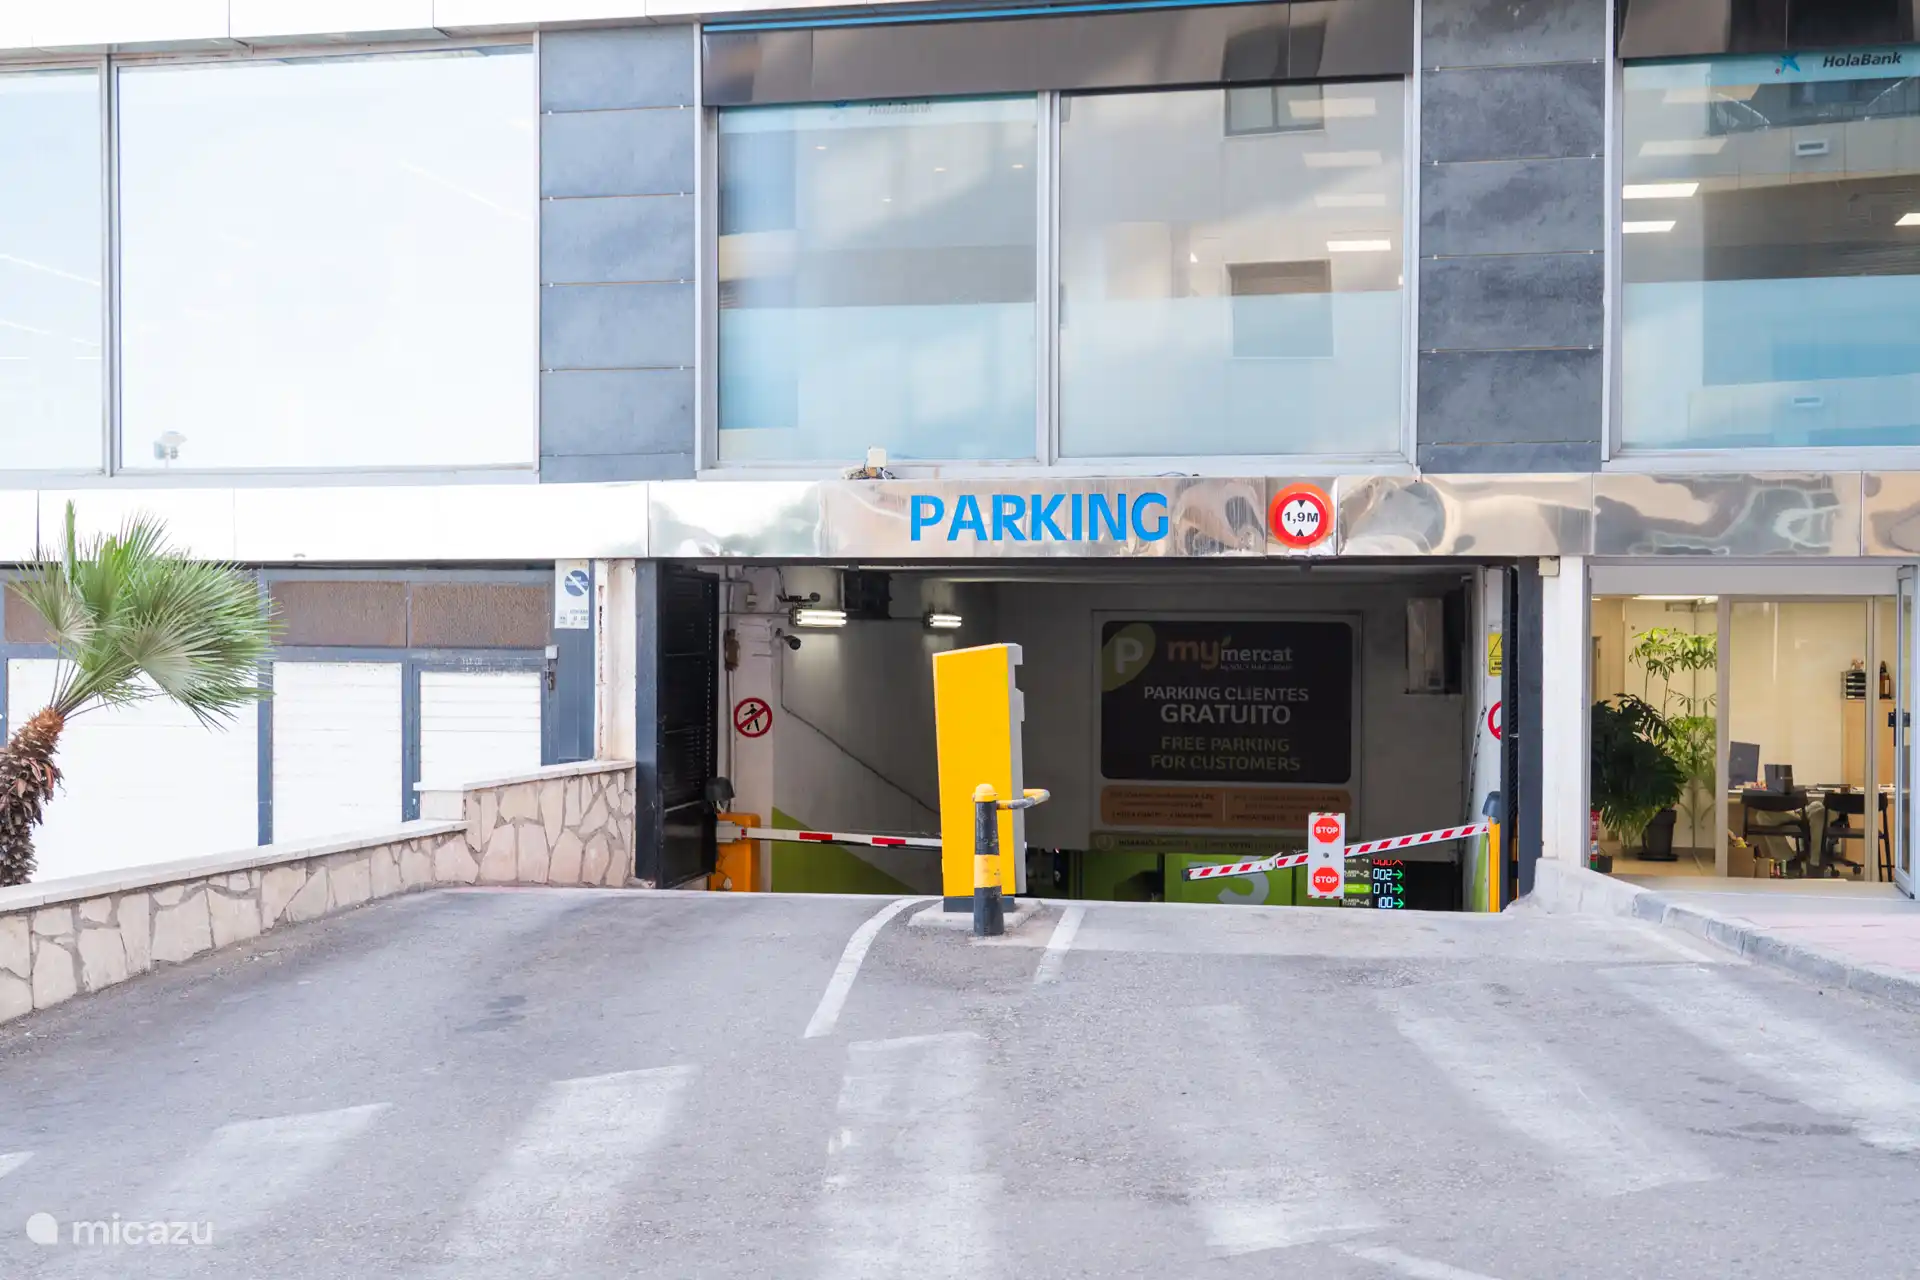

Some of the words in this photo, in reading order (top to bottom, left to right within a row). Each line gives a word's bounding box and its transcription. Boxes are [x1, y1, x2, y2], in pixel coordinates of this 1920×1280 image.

[1822, 51, 1902, 68] HolaBank
[909, 492, 1169, 542] PARKING
[1284, 511, 1319, 524] 1,9M
[1114, 637, 1144, 674] P
[1144, 686, 1220, 700] PARKING
[1224, 687, 1309, 702] CLIENTES
[1160, 703, 1291, 725] GRATUITO
[1161, 736, 1206, 751] FREE
[1210, 737, 1290, 753] PARKING
[1150, 754, 1186, 769] FOR
[1190, 756, 1300, 771] CUSTOMERS
[1315, 826, 1338, 834] STOP
[1315, 875, 1338, 883] STOP
[1373, 868, 1393, 881] 002
[1373, 882, 1393, 895] 017
[1378, 896, 1393, 909] 100
